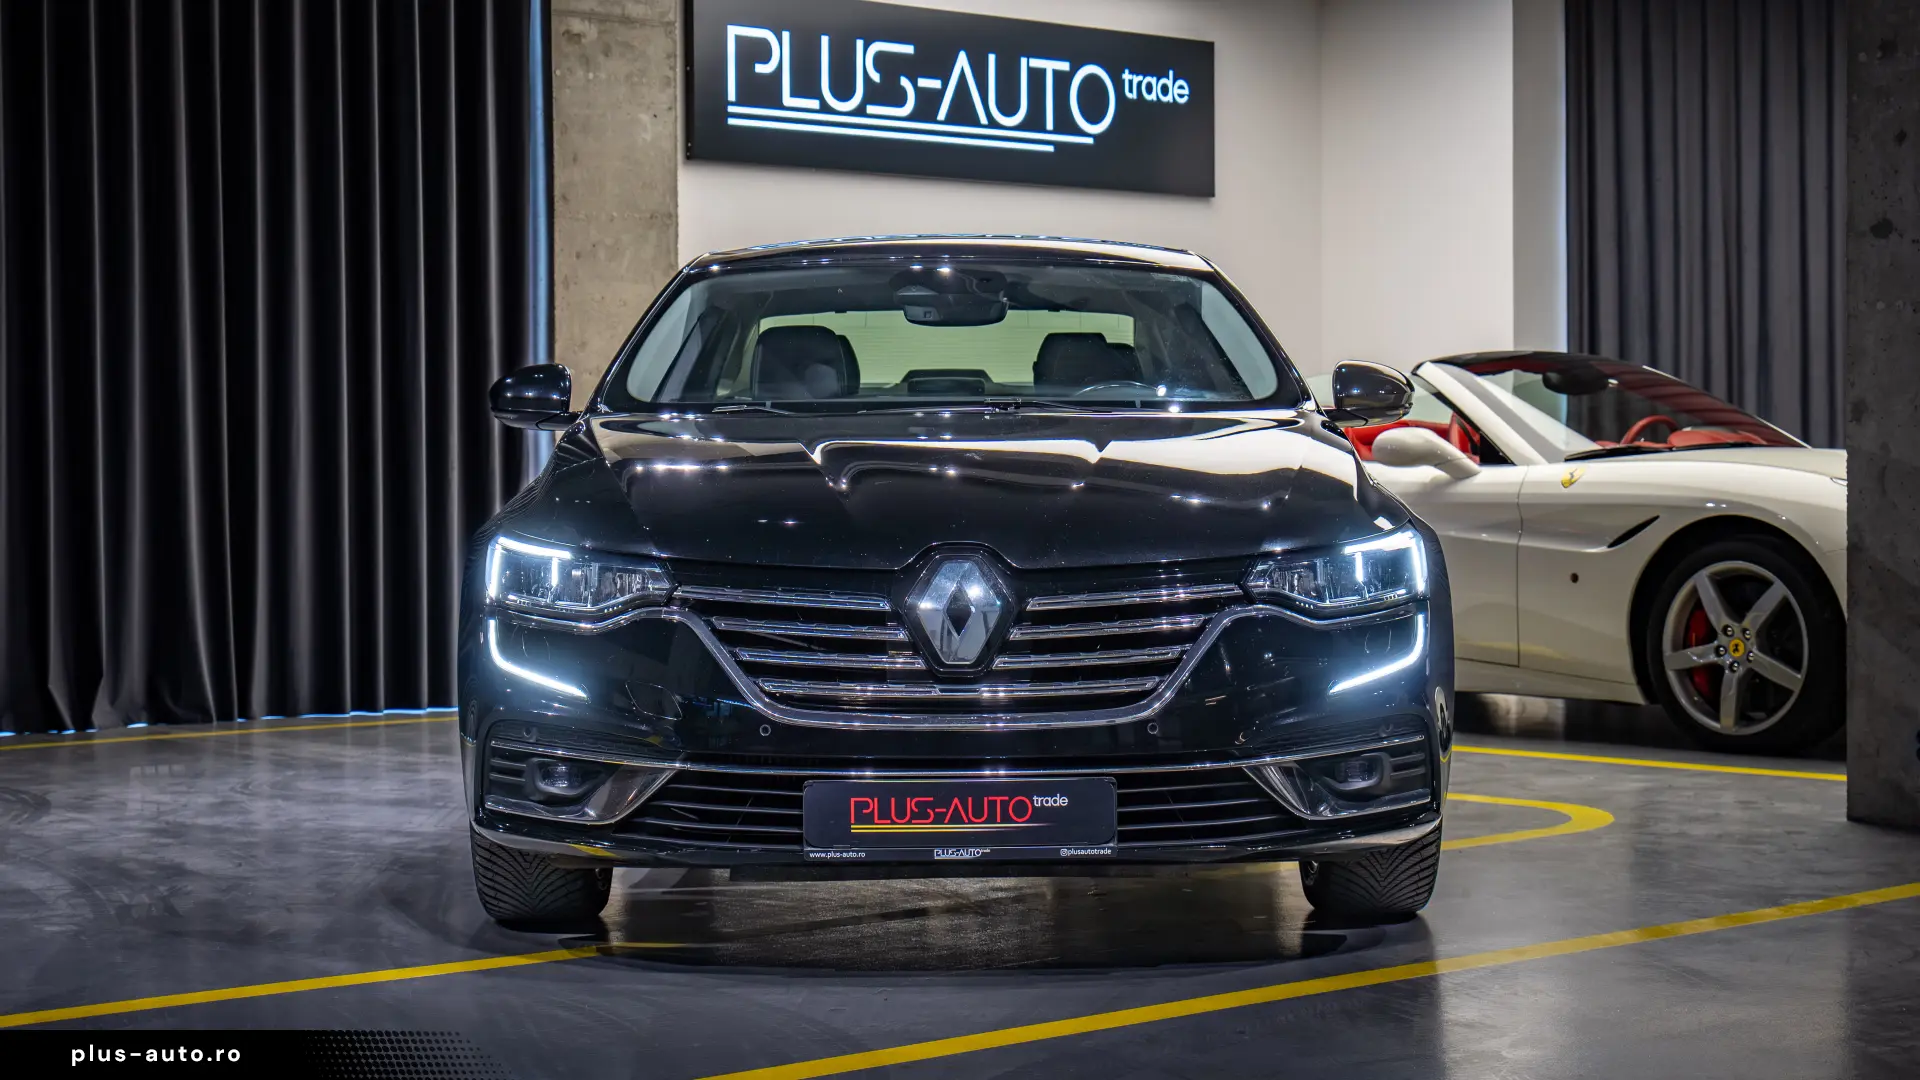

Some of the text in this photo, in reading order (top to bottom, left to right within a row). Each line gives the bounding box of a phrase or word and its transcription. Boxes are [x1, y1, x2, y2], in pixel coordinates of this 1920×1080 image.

[726, 24, 1189, 135] PLUS-AUTO trade
[850, 793, 1069, 824] PLUS-AUTO trade
[809, 851, 866, 859] www.plus-auto.ro
[934, 848, 982, 857] PLUS-AUTO
